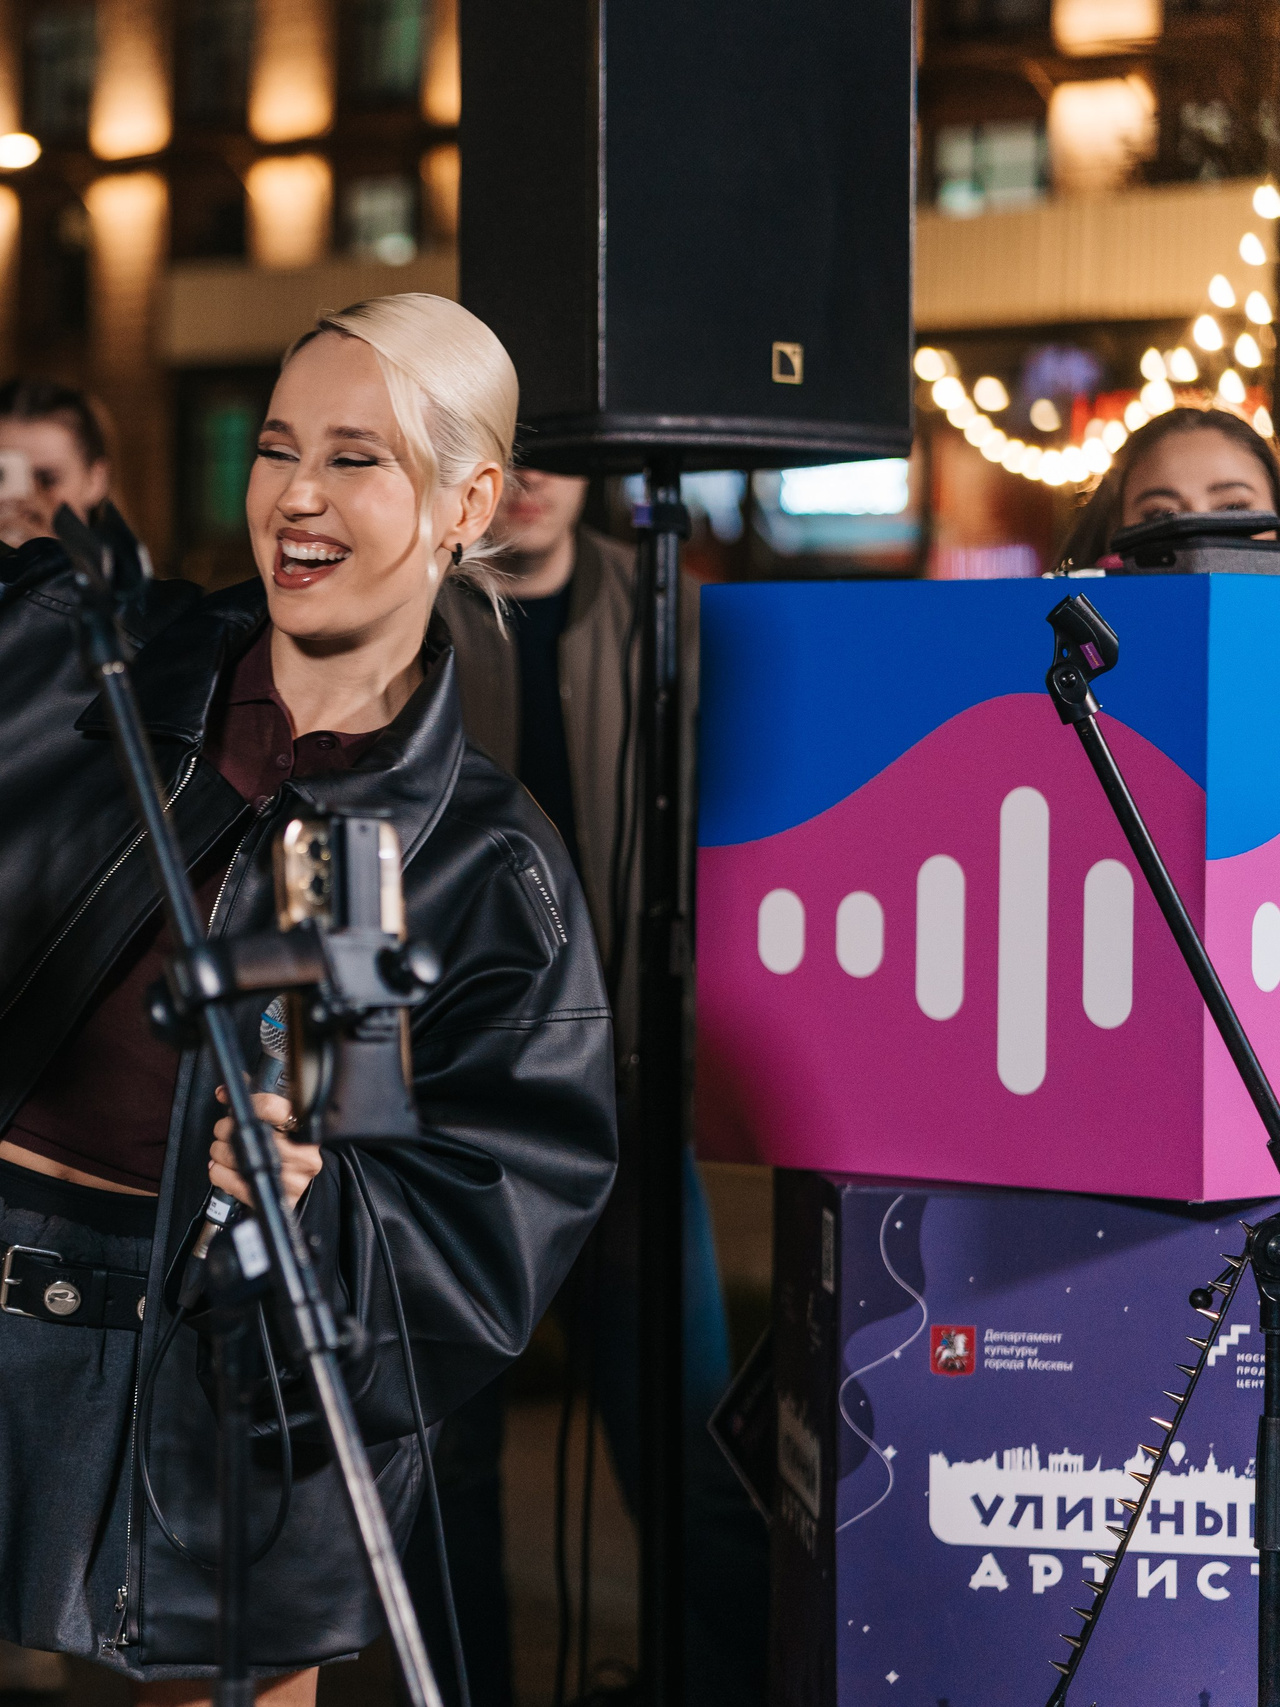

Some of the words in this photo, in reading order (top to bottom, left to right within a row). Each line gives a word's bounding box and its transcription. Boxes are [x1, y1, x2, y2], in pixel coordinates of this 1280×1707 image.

[539, 887, 552, 904] post
[983, 1328, 1063, 1344] Департамент
[984, 1345, 1038, 1358] культуры
[984, 1358, 1025, 1371] города
[1027, 1357, 1074, 1371] Москвы
[969, 1493, 1256, 1538] УЛИЧНЫ
[968, 1552, 1259, 1601] АРТИС
